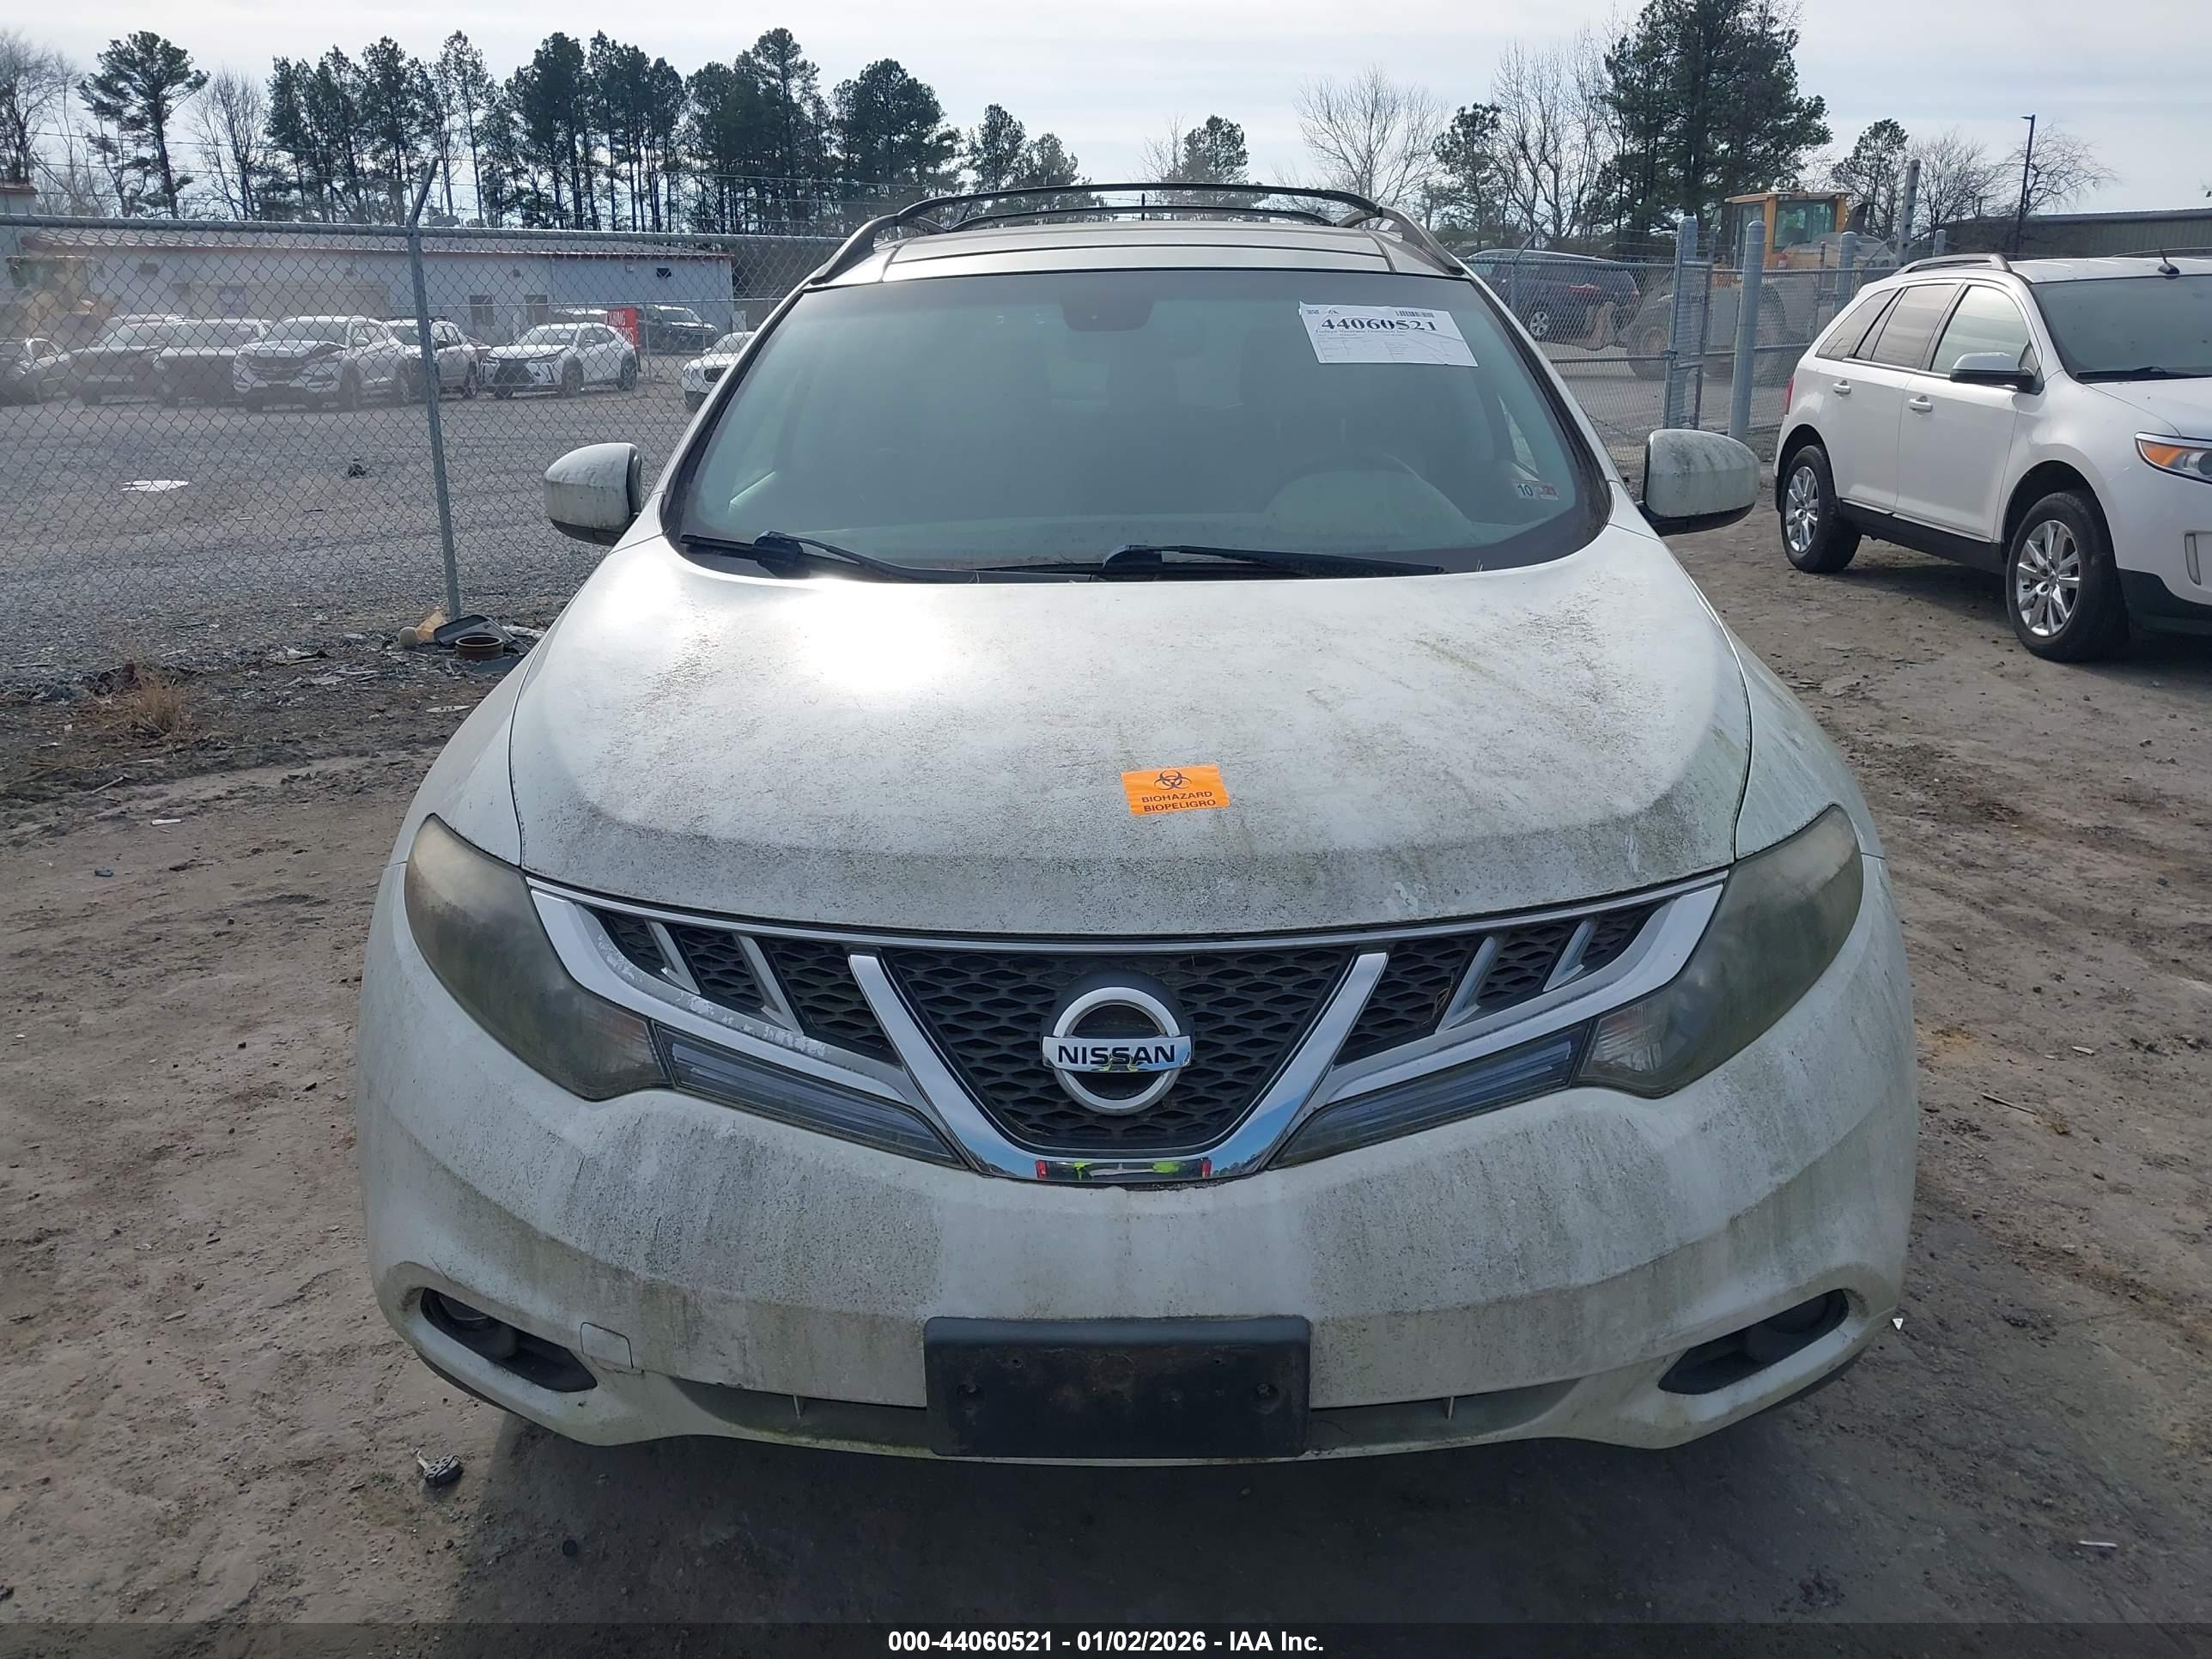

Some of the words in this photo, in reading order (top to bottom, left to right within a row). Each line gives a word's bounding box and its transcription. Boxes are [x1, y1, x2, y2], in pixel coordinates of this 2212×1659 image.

[1321, 318, 1439, 331] 44060521
[1517, 483, 1534, 496] 10
[1141, 791, 1212, 803] BIOHAZARD
[1143, 799, 1217, 812] BIOPELIGRO
[1058, 1044, 1176, 1065] NISSAN
